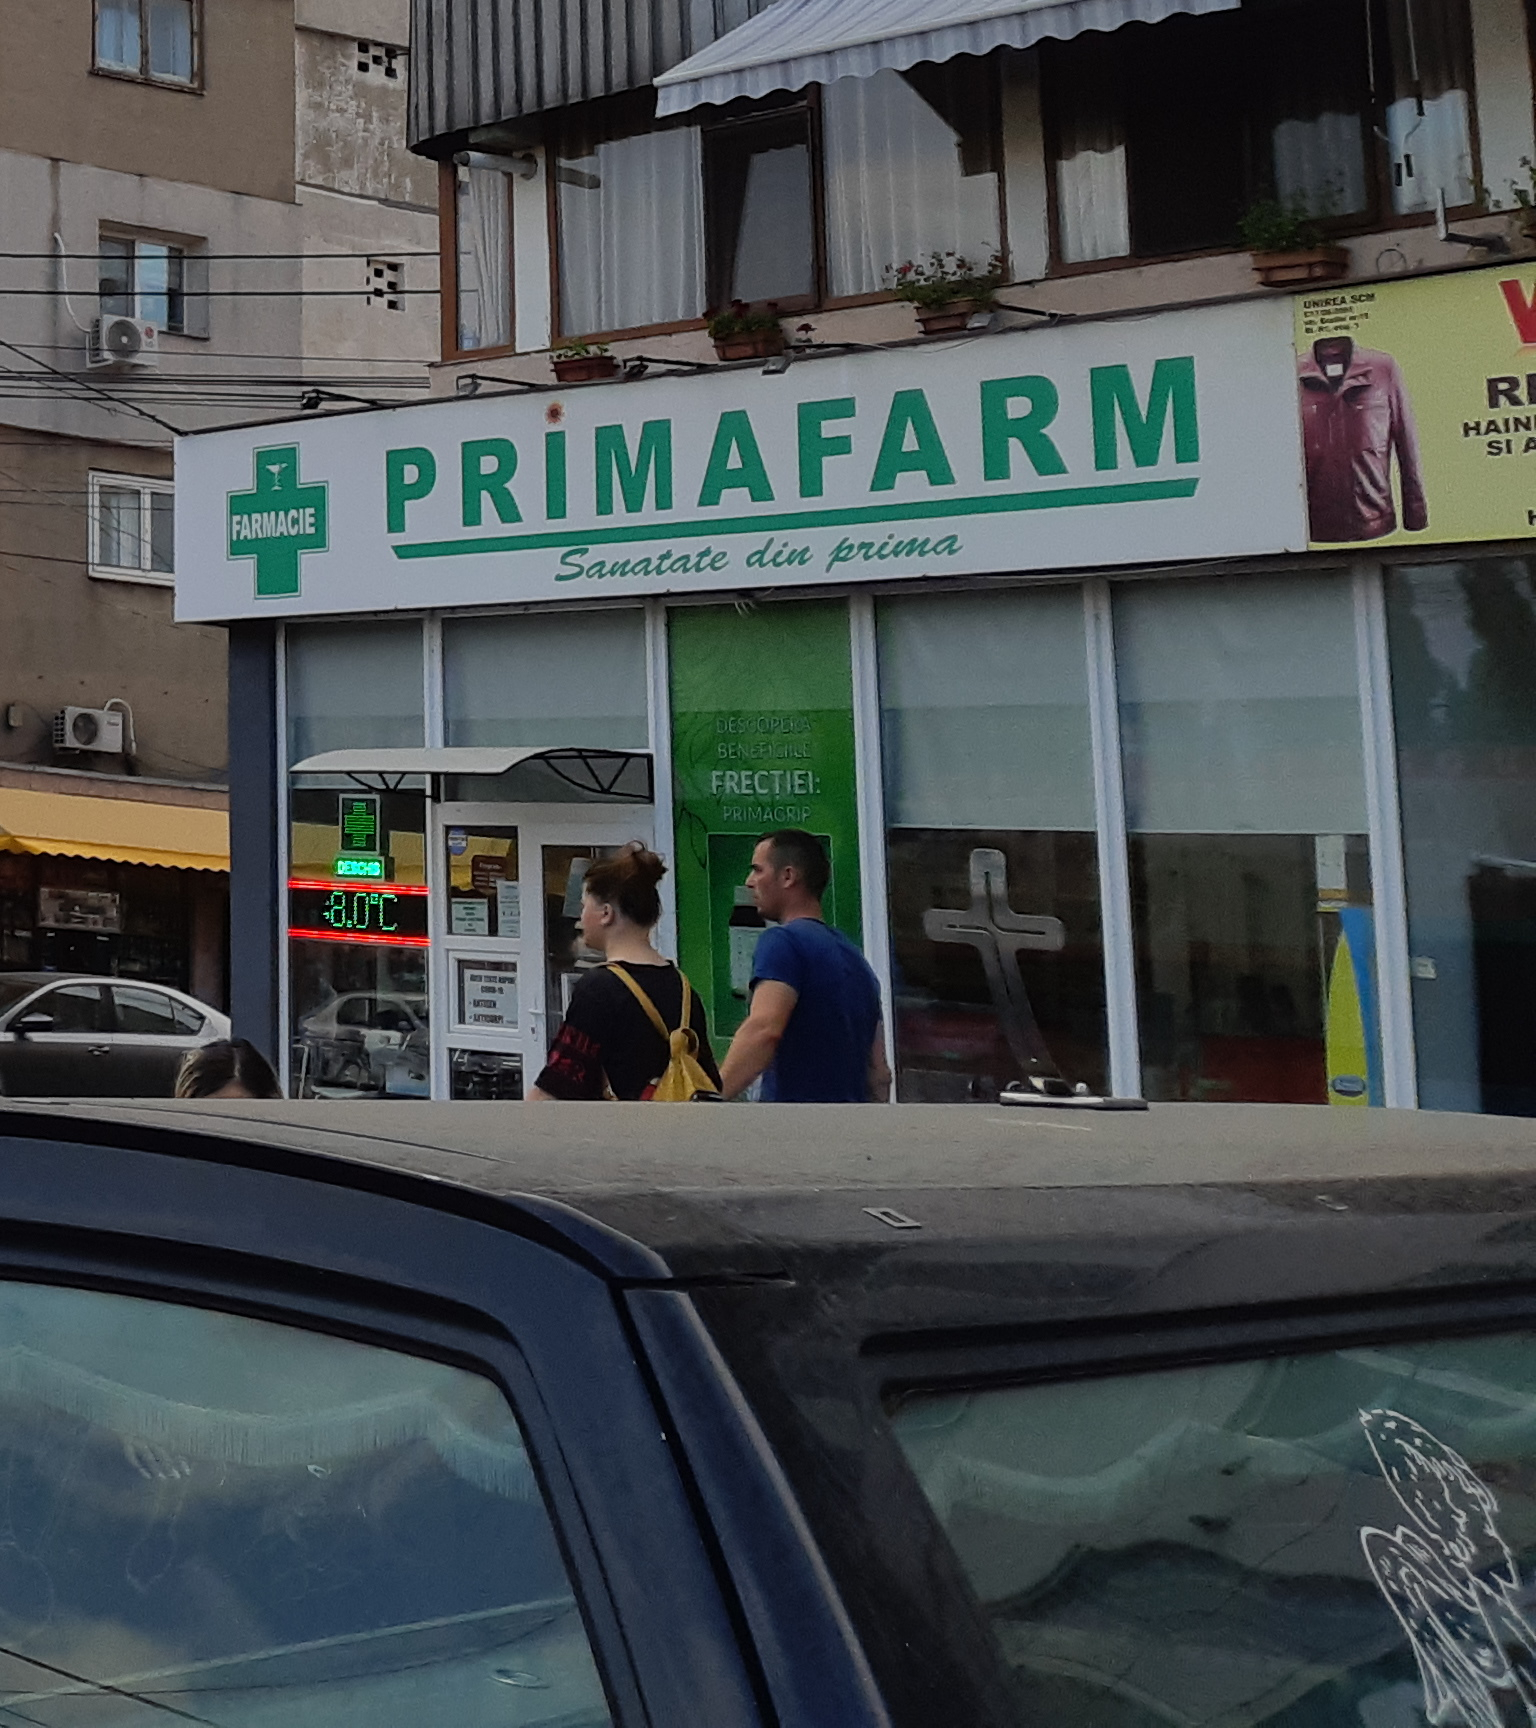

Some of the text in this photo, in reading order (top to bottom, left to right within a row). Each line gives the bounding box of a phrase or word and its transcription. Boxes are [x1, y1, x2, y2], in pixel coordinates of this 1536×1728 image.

[386, 356, 1200, 534] PRIMAFARM
[231, 507, 316, 541] FARMACIE
[555, 533, 964, 583] Sanatate din prima
